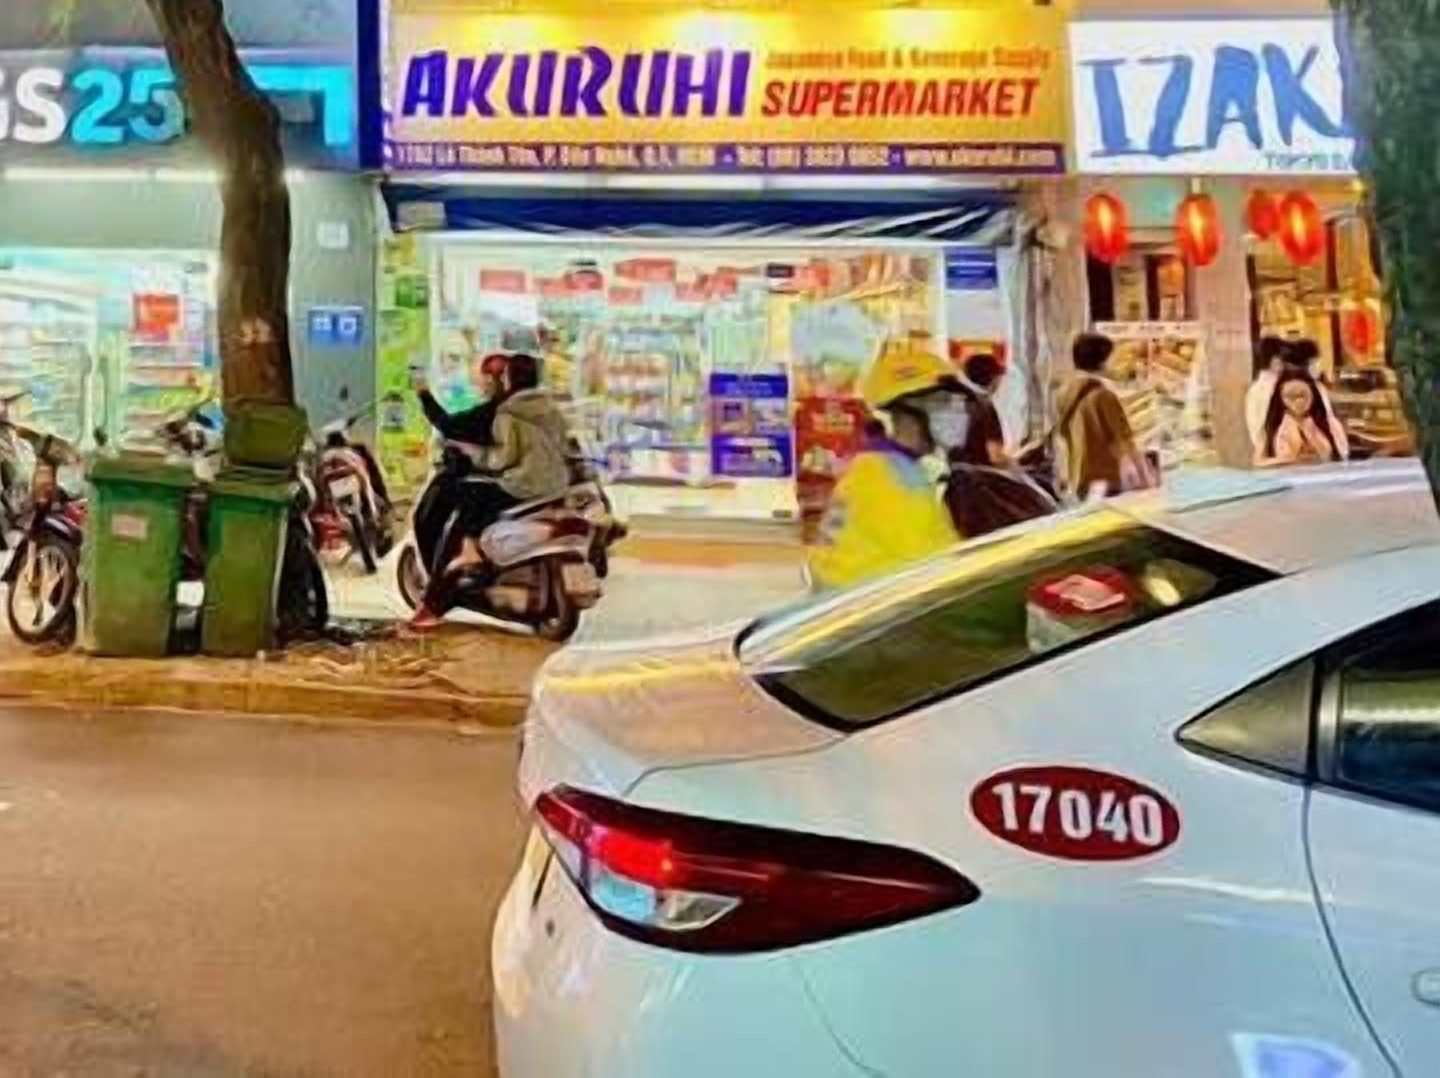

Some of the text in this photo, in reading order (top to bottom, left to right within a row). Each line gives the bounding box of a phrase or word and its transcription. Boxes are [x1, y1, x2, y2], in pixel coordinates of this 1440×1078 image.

[401, 46, 751, 117] AKURUHI
[761, 77, 1041, 118] SUPERMARKET
[991, 782, 1165, 847] 17040
